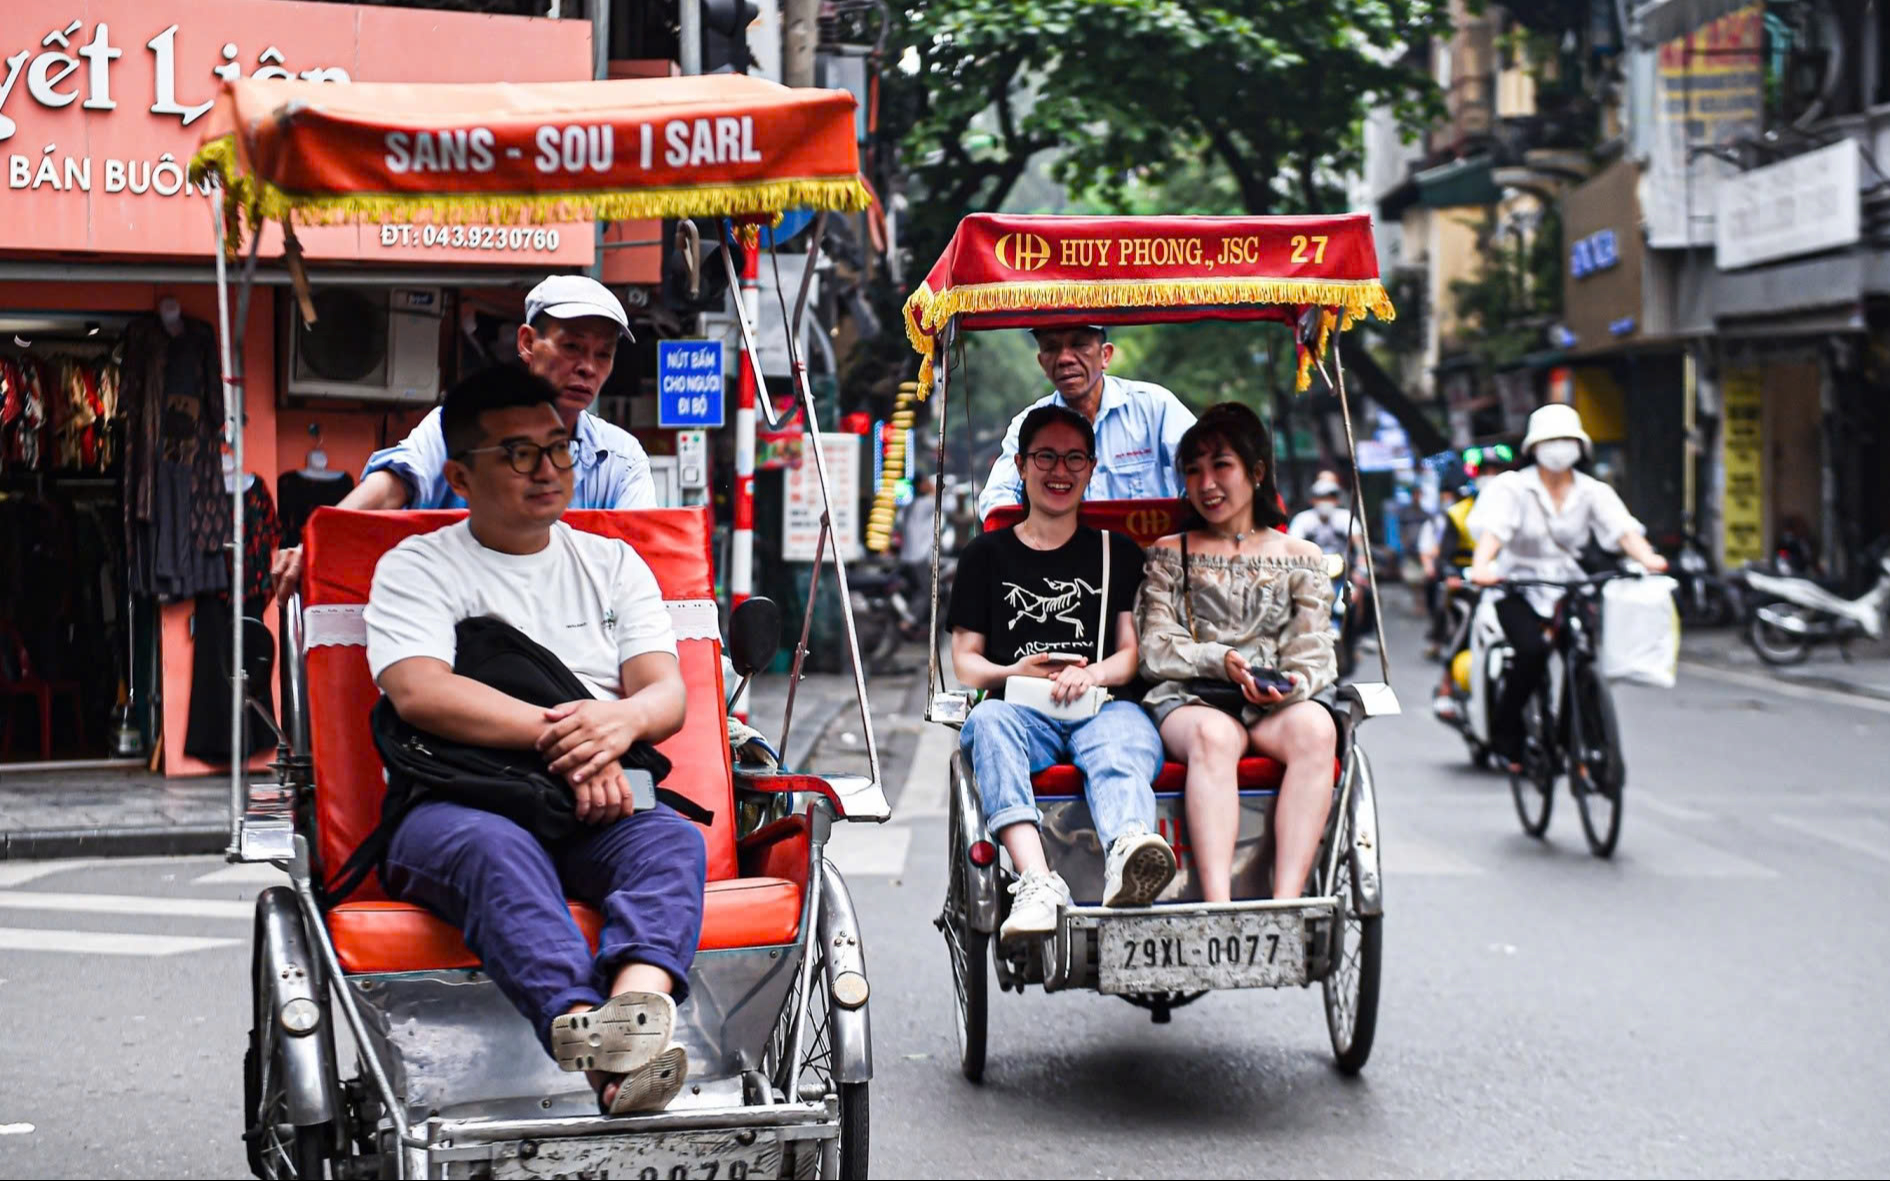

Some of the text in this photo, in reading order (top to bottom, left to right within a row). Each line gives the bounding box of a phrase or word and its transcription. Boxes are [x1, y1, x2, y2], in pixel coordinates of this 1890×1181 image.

[384, 126, 496, 173] SANS
[535, 124, 614, 173] SOU
[665, 115, 762, 168] SARL
[9, 143, 91, 191] BÁN
[1060, 239, 1112, 267] HUY
[1290, 234, 1328, 264] 27
[663, 375, 686, 393] CHO
[1123, 934, 1280, 970] 29XL-0077
